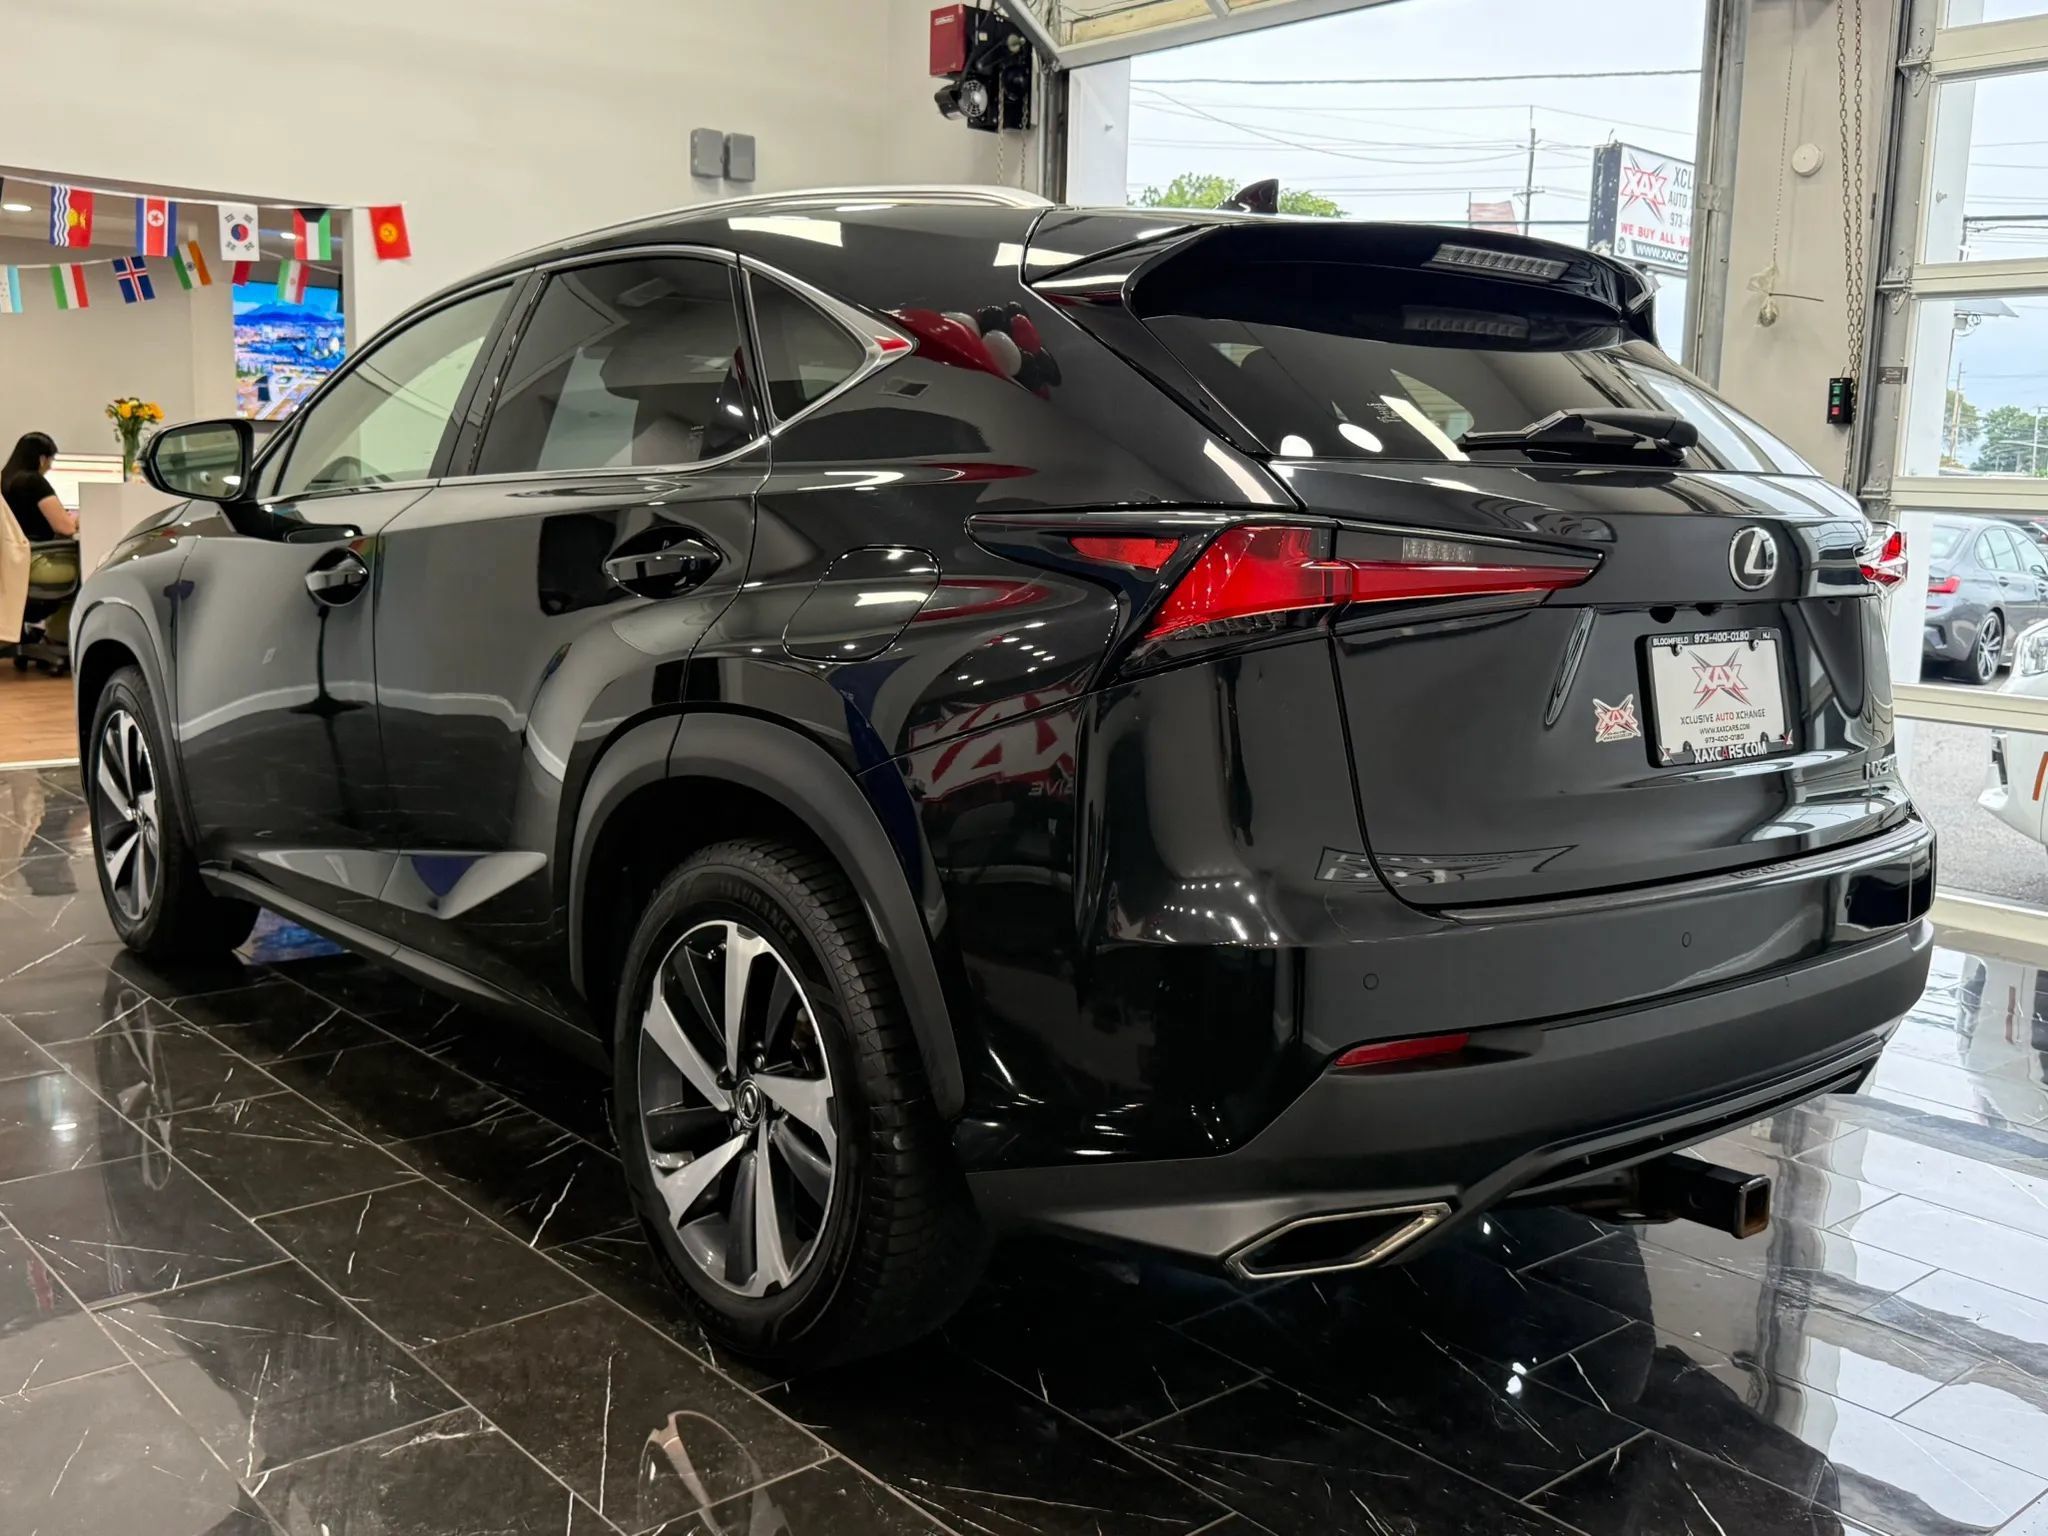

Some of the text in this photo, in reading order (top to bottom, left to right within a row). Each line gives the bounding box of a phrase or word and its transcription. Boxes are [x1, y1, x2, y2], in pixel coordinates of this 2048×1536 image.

[1621, 166, 1667, 206] XAX
[1668, 190, 1688, 209] AUTO
[1620, 222, 1634, 236] WE
[1638, 226, 1655, 240] BUY
[1660, 231, 1675, 245] ALL
[1653, 636, 1689, 646] BLOOMFIELD
[1694, 631, 1750, 643] 973-400-0180
[1680, 708, 1766, 725] XCLUSIVE AUTO XCHANGE
[1700, 723, 1751, 735] WWW.XAXCARS.COM
[1704, 733, 1745, 744] 973-400-0180
[1694, 741, 1767, 764] XAXCARS.COM
